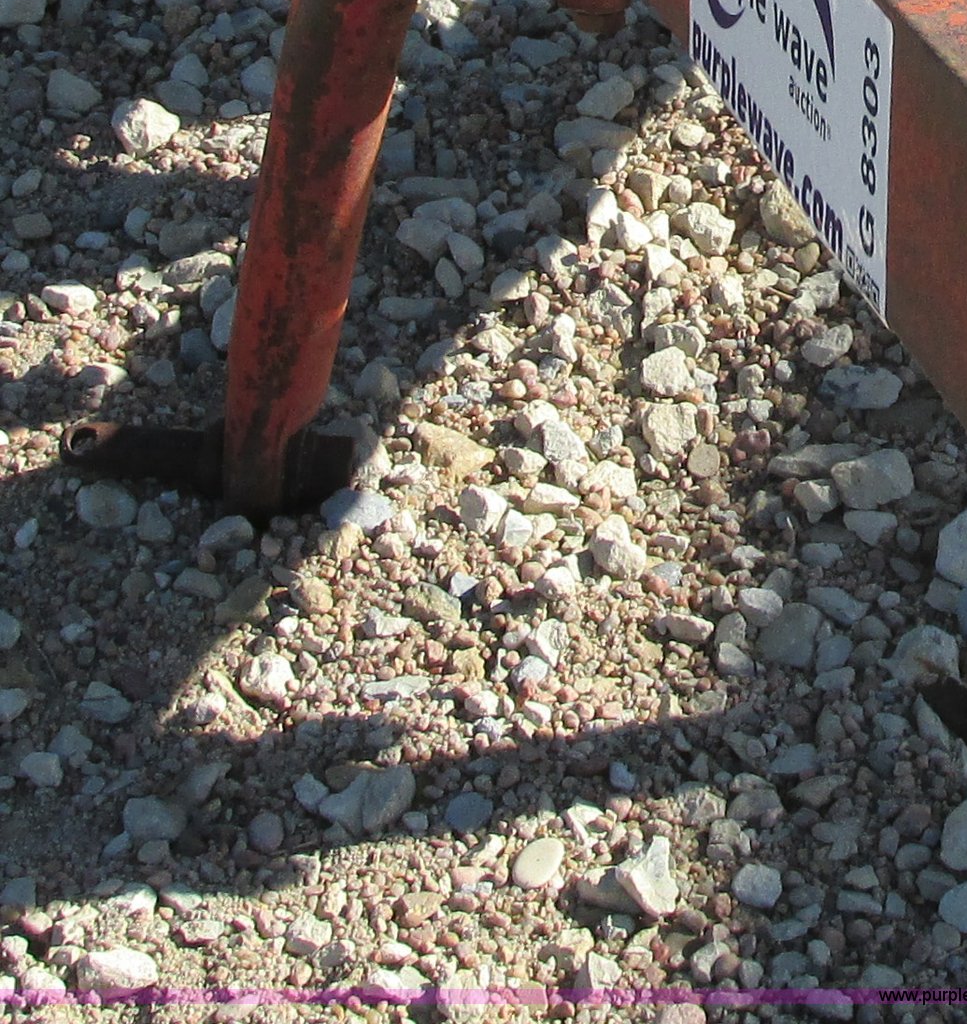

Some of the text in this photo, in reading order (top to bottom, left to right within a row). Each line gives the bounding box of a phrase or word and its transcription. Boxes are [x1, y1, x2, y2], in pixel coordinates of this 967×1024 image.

[772, 0, 829, 104] wave
[860, 37, 881, 197] 8303
[693, 19, 843, 262] purplewave.com
